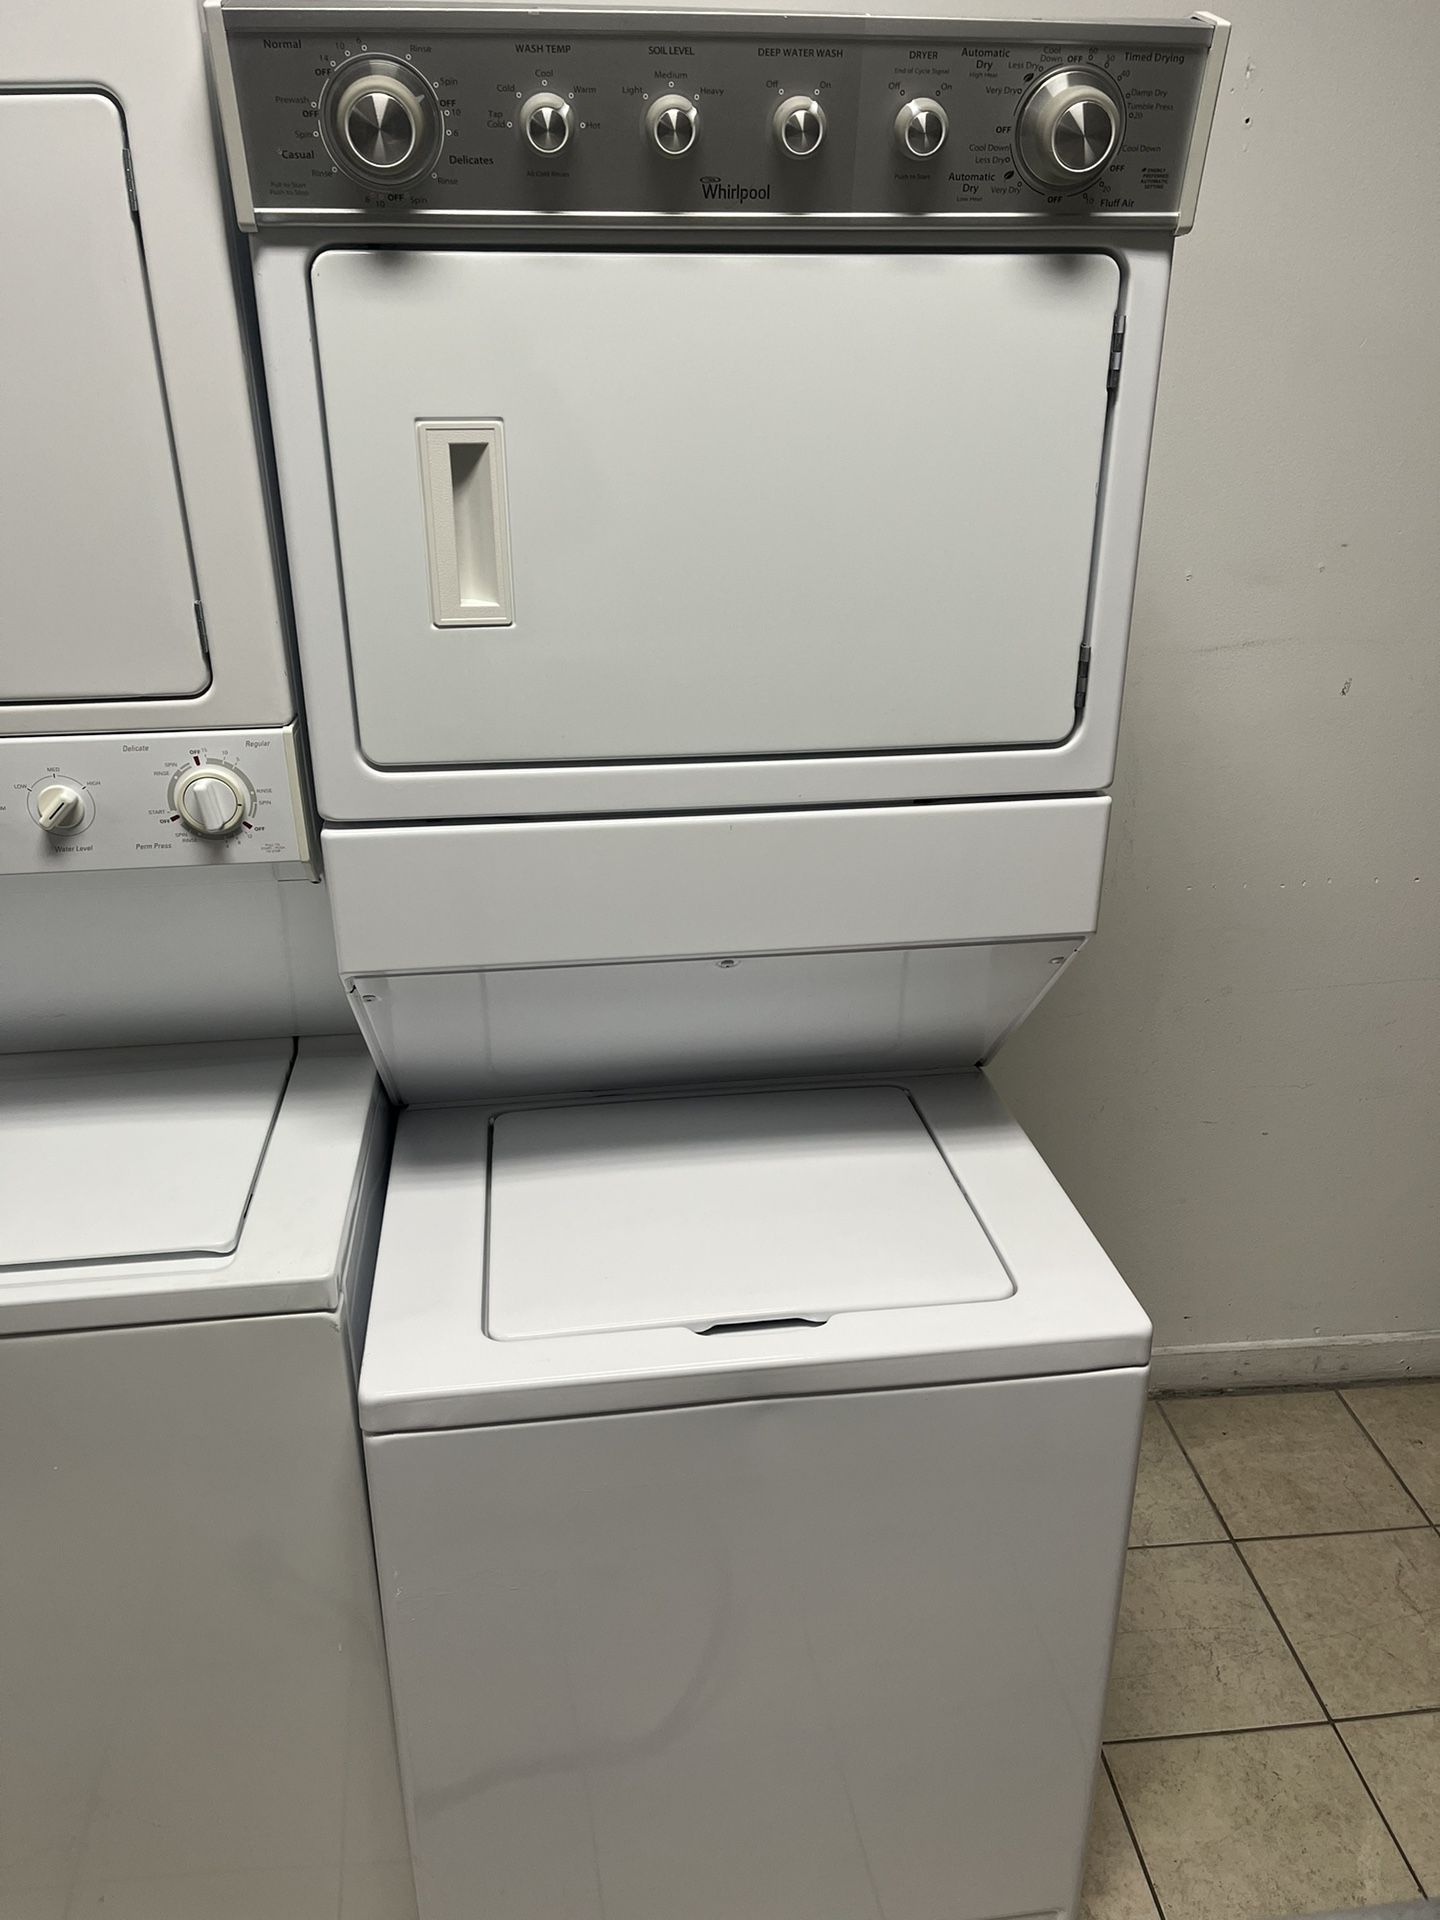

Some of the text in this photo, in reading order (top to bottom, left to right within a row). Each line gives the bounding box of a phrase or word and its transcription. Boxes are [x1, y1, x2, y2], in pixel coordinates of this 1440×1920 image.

[263, 40, 302, 49] Normal
[409, 44, 432, 53] Rinse
[515, 44, 571, 54] WASH TEMP
[648, 46, 695, 56] SOIL LEVEL
[757, 47, 844, 58] DEEP WATER WASH
[961, 47, 1010, 58] Automatic
[1043, 46, 1061, 54] Cool
[909, 50, 938, 60] DRYER
[1067, 55, 1082, 63] OFF
[1124, 51, 1185, 65] Timed Drying
[976, 60, 993, 71] Dry
[1008, 61, 1024, 70] Less
[315, 68, 331, 77] OFF
[534, 69, 553, 77] Cool
[654, 71, 688, 79] Medium
[440, 78, 458, 87] Spin
[765, 80, 778, 88] Off
[820, 81, 831, 89] On
[888, 82, 901, 90] Off
[940, 83, 953, 91] On
[496, 84, 515, 92] Cold
[573, 85, 596, 94] Warm
[622, 86, 643, 95] Light
[700, 87, 724, 96] Heavy
[985, 85, 1018, 96] Very Dry
[1131, 88, 1167, 98] Damp Dry
[275, 95, 309, 104] Prewash
[440, 99, 456, 108] OFF
[1127, 102, 1154, 111] Tumble
[302, 110, 318, 118] OFF
[488, 110, 503, 119] Tap
[487, 120, 505, 128] Cold
[586, 121, 600, 130] Hot
[995, 126, 1012, 134] OFF
[969, 144, 1010, 152] Cool Down
[1121, 145, 1162, 153] Cool Down
[281, 150, 315, 159] Casual
[449, 155, 494, 165] Delicates
[975, 156, 992, 164] Less
[1109, 164, 1125, 173] OFF
[948, 172, 996, 181] Automatic
[962, 183, 980, 194] Dry
[991, 186, 1020, 195] Very Dry
[387, 193, 404, 201] OFF
[702, 183, 771, 205] Whirlpool
[411, 195, 427, 204] Spin
[1047, 196, 1063, 204] OFF
[1099, 199, 1134, 209] Fluff Air
[245, 740, 271, 748] Regular
[75, 845, 94, 853] Level
[135, 842, 173, 851] Perm Press
